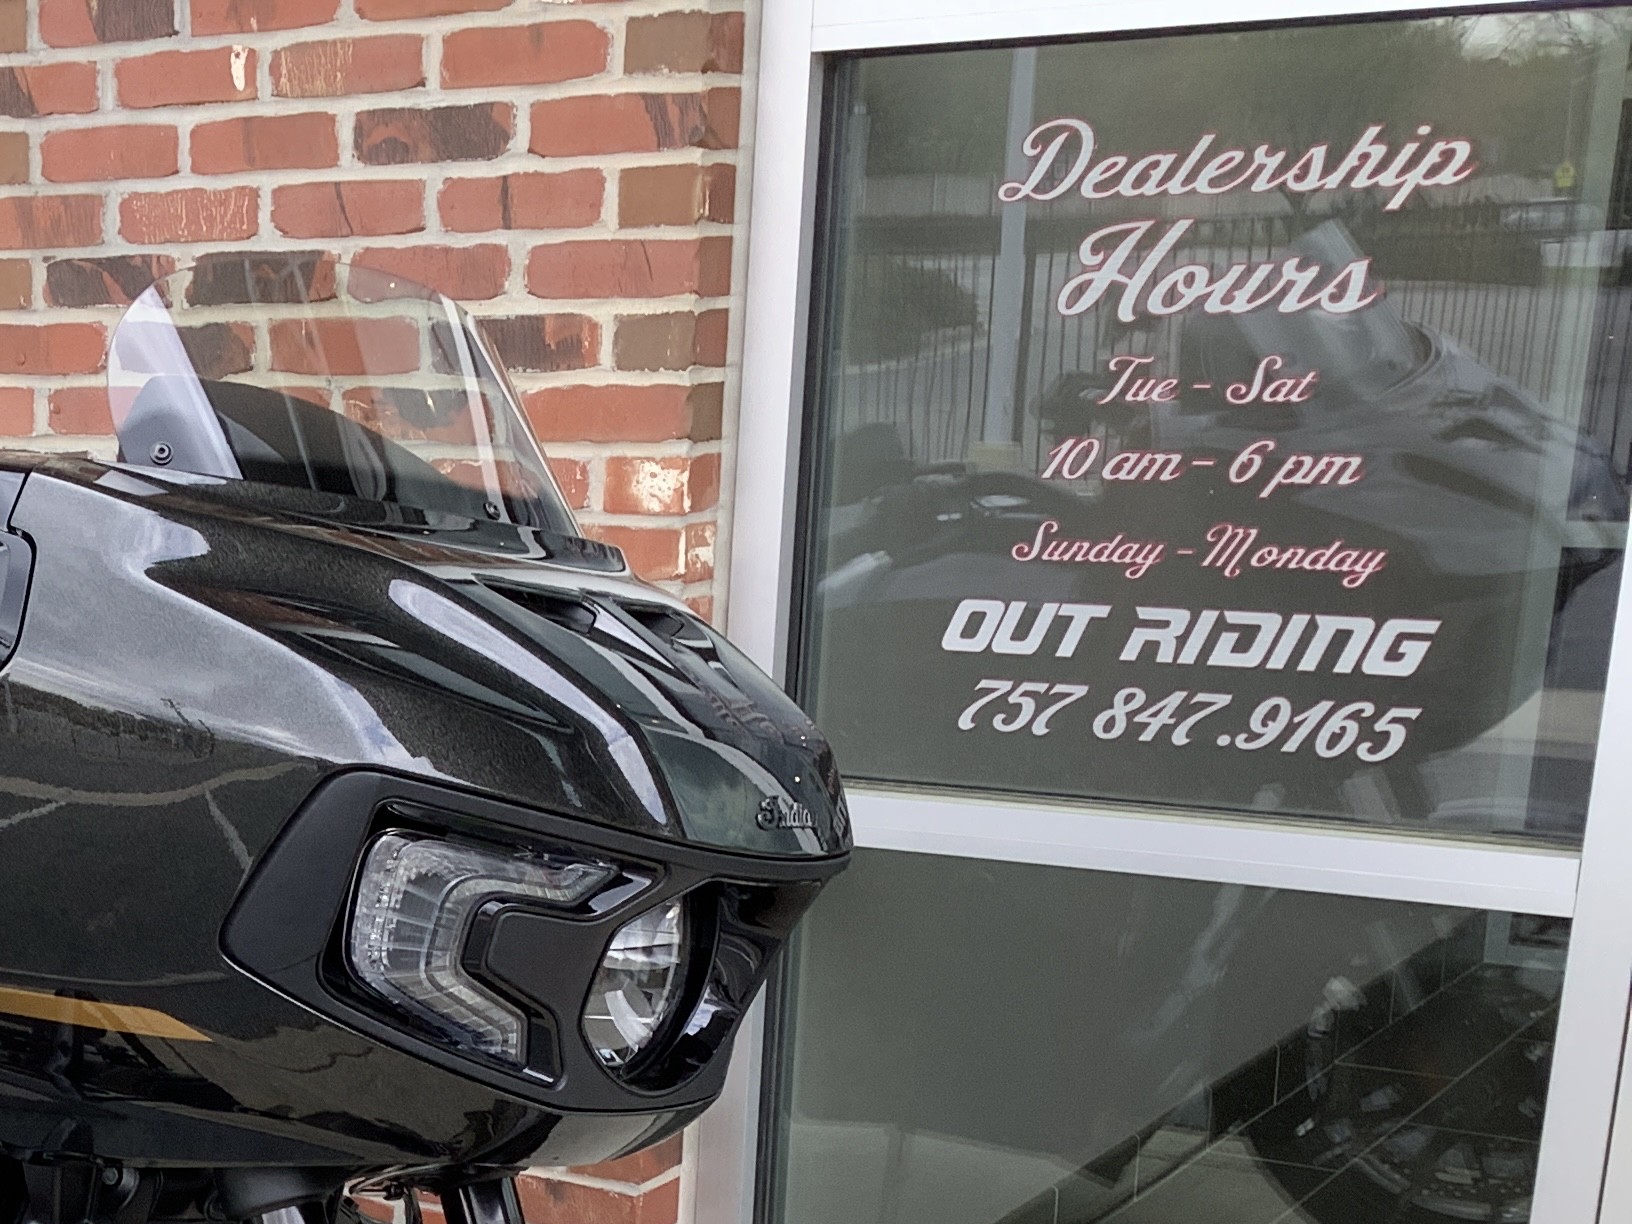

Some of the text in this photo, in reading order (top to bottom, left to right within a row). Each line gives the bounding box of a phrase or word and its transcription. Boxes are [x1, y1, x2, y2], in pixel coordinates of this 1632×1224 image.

[998, 117, 1478, 210] Dealership
[1056, 219, 1384, 322] Hours
[1098, 355, 1179, 406] Tue
[1226, 355, 1322, 404] Sat
[1041, 438, 1100, 482] 10
[1103, 450, 1181, 483] am
[1229, 439, 1274, 483] 6
[1260, 450, 1363, 498] pm
[1011, 520, 1165, 579] Sunday
[1201, 523, 1387, 587] Monday
[942, 598, 1442, 677] OUT RIDING
[957, 679, 1423, 762] 757 847.9165
